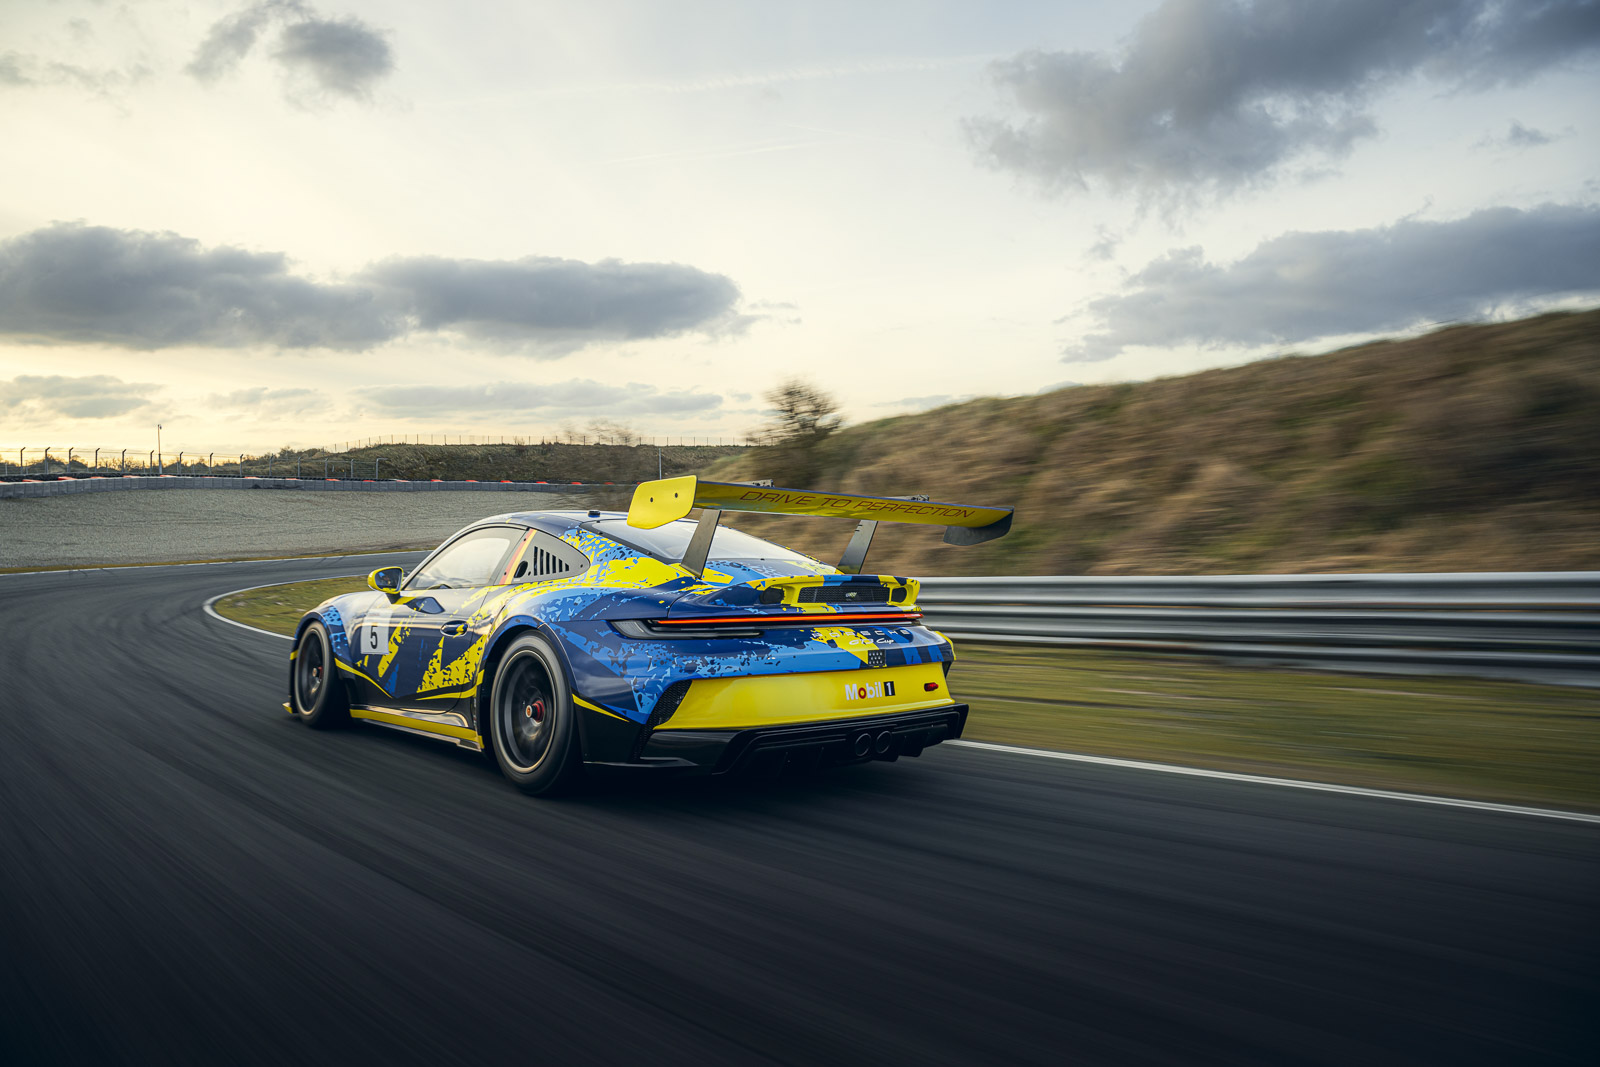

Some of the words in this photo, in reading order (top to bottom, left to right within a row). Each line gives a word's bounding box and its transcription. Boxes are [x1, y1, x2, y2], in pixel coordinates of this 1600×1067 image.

[740, 491, 816, 505] DRIVE
[821, 497, 852, 508] TO
[853, 500, 976, 518] PERFECTION
[370, 625, 378, 649] 5
[811, 630, 910, 638] PORSCHE
[848, 638, 874, 646] GT3
[876, 637, 894, 645] Cup
[845, 682, 882, 700] Mobil
[885, 681, 894, 696] 1
